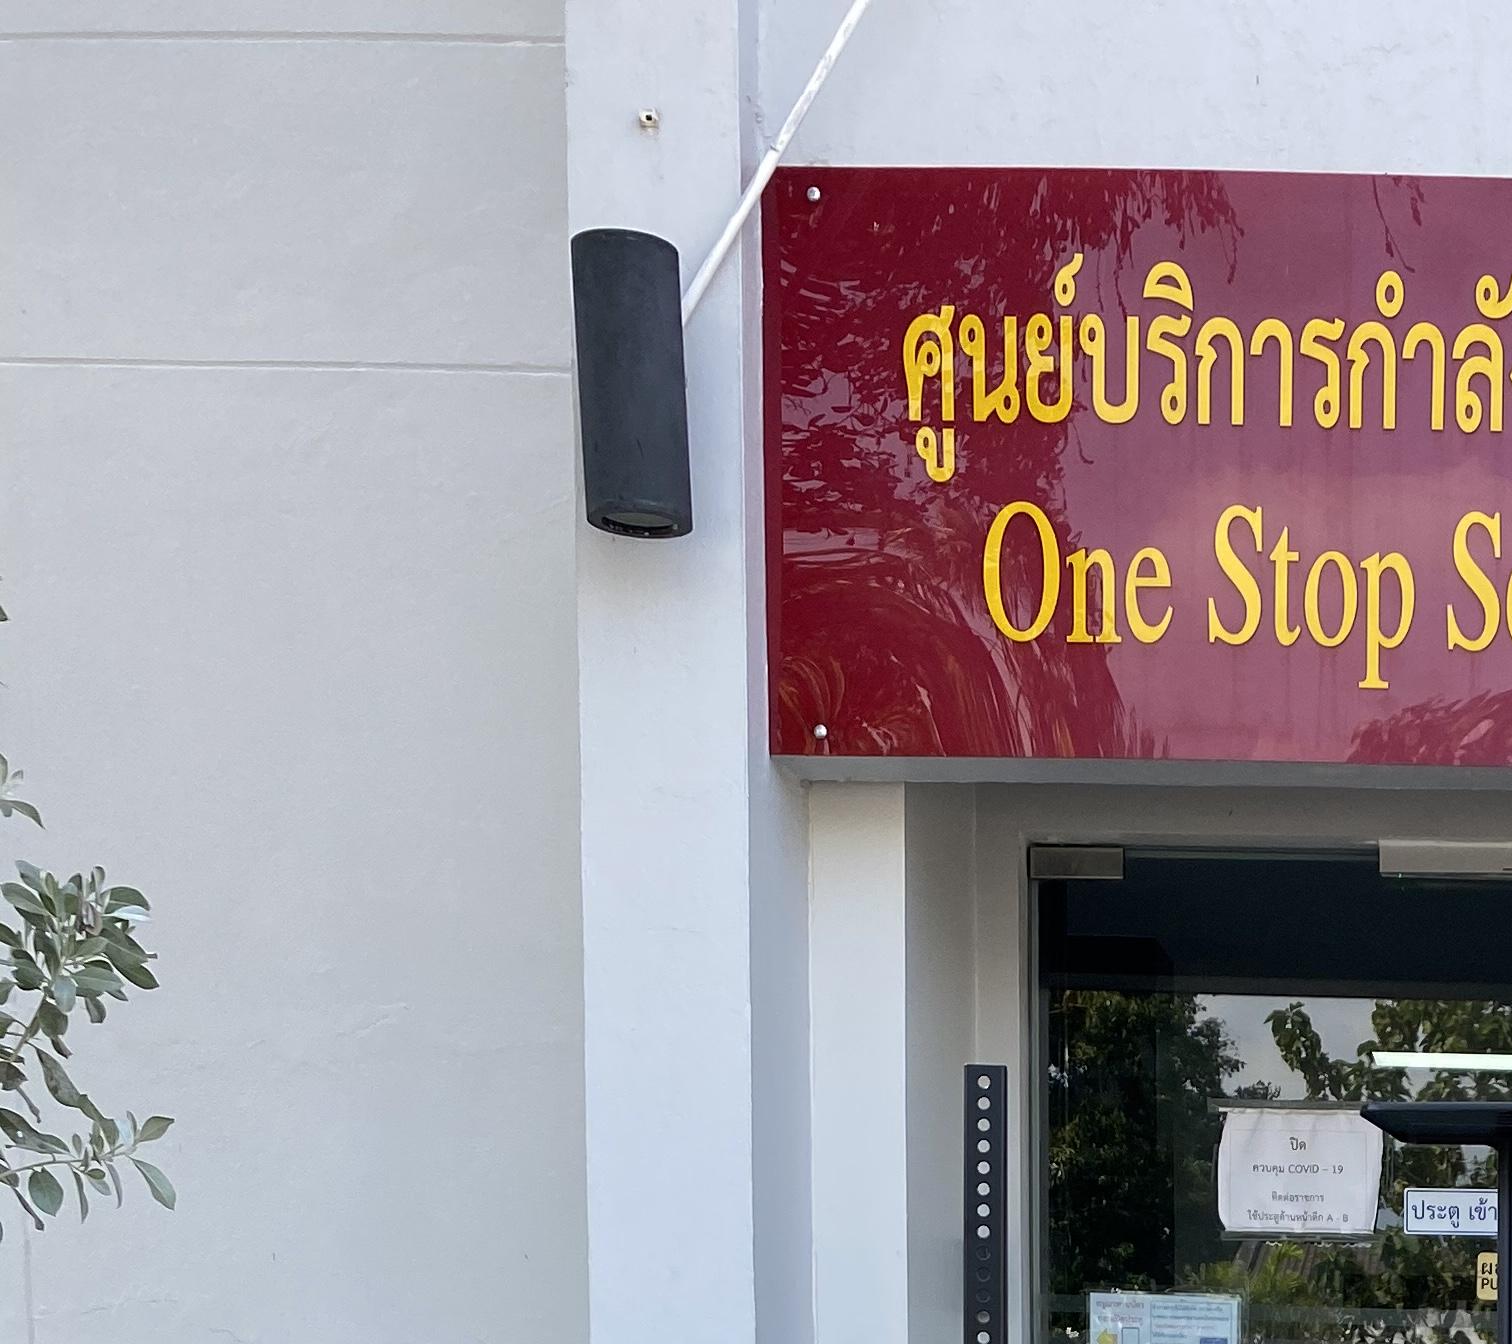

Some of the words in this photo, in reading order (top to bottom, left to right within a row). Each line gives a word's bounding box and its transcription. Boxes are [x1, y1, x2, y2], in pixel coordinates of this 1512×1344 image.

[981, 501, 1170, 645] One
[1209, 507, 1414, 690] Stop
[1289, 1136, 1307, 1151] ปิด
[1252, 1165, 1285, 1177] ควบคุม
[1288, 1164, 1320, 1175] COVID
[1332, 1164, 1344, 1175] 19
[1326, 1213, 1334, 1223] A
[1411, 1200, 1460, 1229] ประตู
[1468, 1196, 1498, 1221] เข้า
